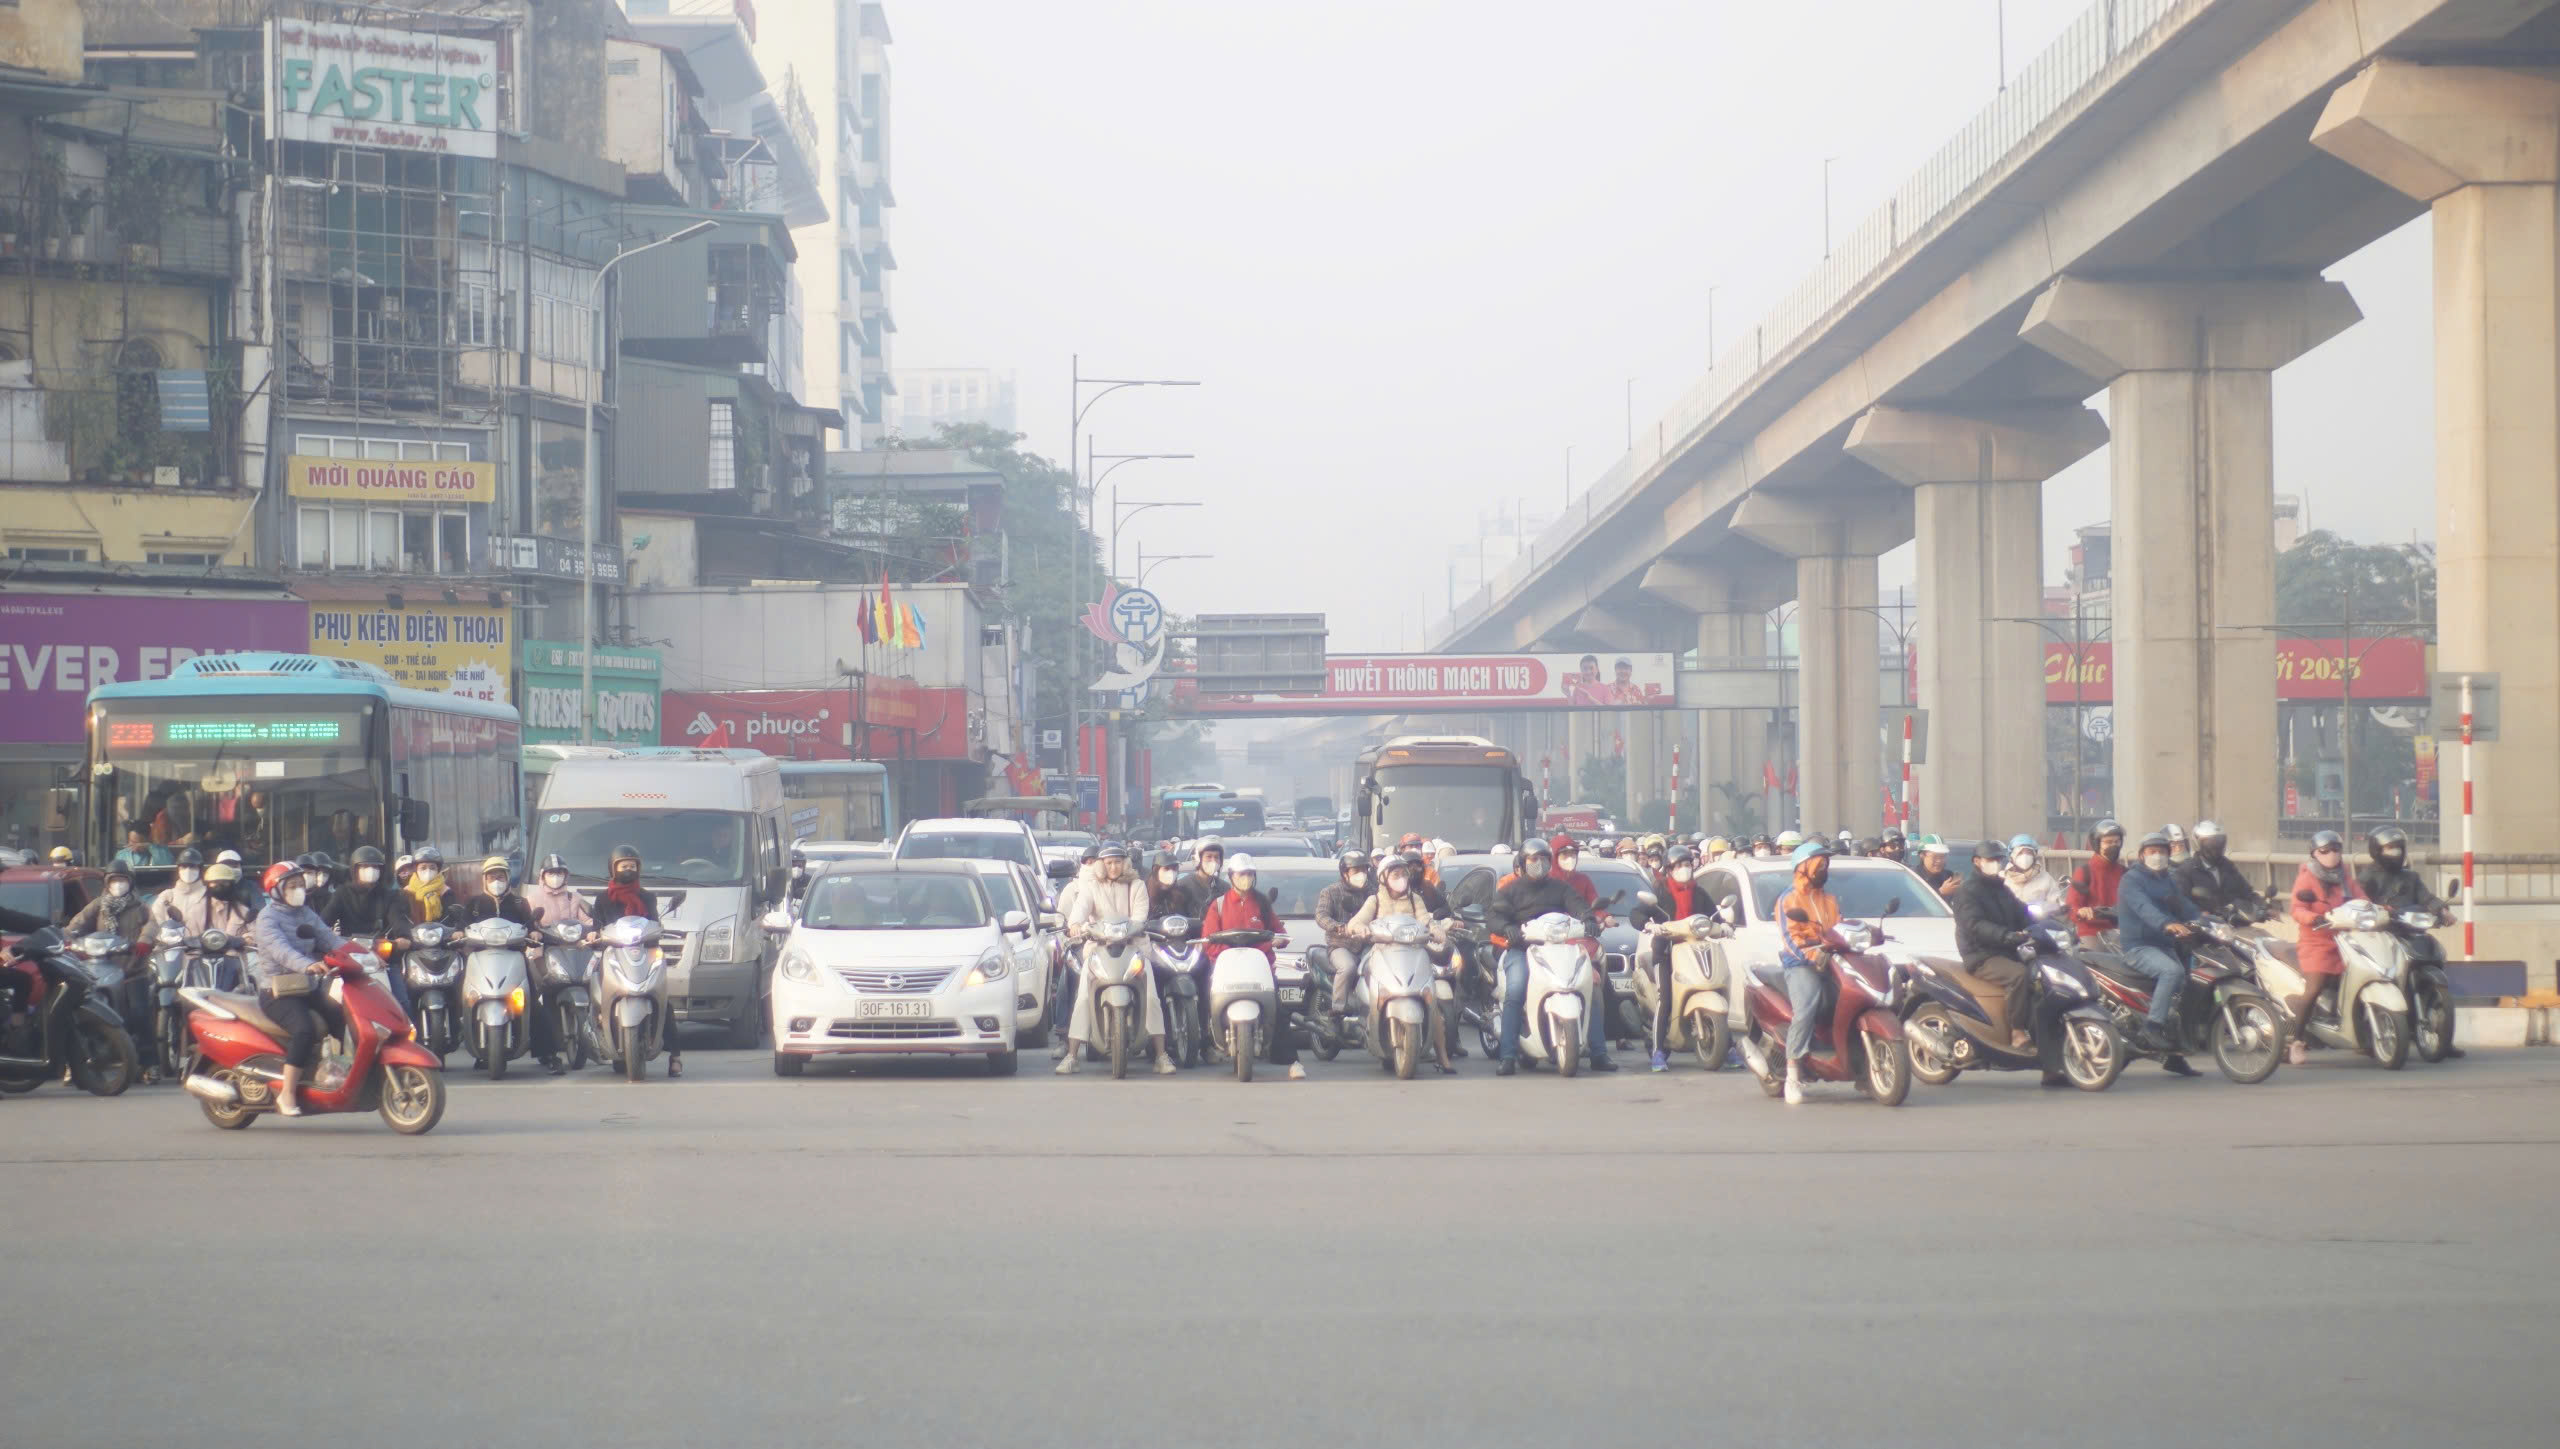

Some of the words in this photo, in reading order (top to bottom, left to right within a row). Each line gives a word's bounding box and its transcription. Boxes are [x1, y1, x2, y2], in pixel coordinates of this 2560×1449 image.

[282, 59, 482, 130] FASTER
[332, 126, 448, 150] www.faster.vn
[308, 463, 349, 487] MỜI
[356, 463, 428, 489] QUẢNG
[434, 467, 475, 490] CÁO
[313, 612, 352, 647] PHỤ
[357, 608, 400, 648] KIỆN
[405, 609, 448, 649] ĐIỆN
[453, 615, 505, 649] THOẠI
[384, 655, 399, 666] SIM
[394, 669, 409, 681] PIN
[415, 670, 426, 681] TAI
[428, 670, 449, 681] NGHE
[2044, 652, 2107, 683] Chúc
[2300, 657, 2361, 680] 2025
[1334, 660, 1382, 692] HUYẾT
[1387, 663, 1438, 692] THÔNG
[1443, 666, 1491, 696] MẠCH
[1496, 666, 1530, 690] TW3
[527, 687, 582, 728] FRESH
[861, 1002, 928, 1016] 30F-161.31
